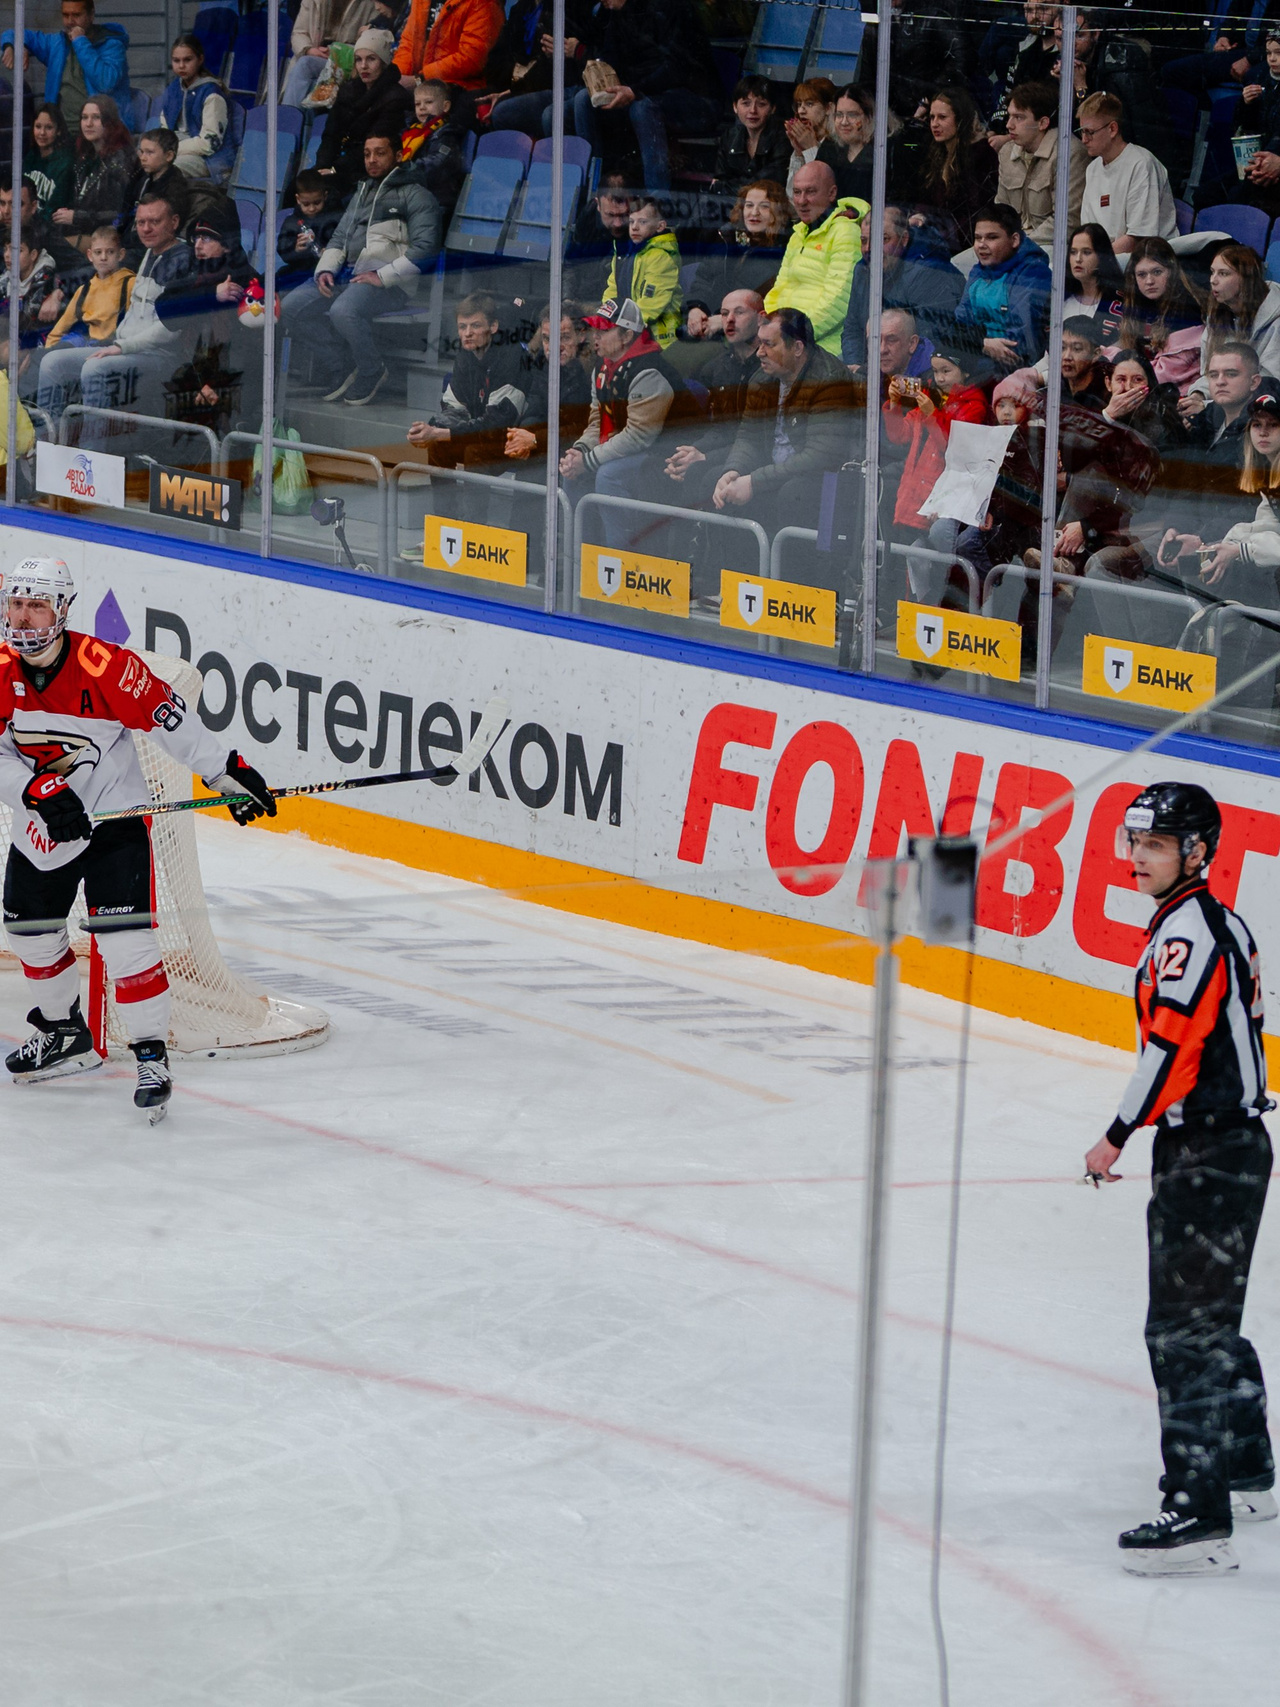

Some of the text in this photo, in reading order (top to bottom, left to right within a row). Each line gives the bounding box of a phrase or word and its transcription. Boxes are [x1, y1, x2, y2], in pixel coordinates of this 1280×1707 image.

[65, 469, 86, 484] АВТО
[70, 482, 96, 498] РАДИО
[160, 472, 230, 523] МАТЧ!
[466, 541, 510, 566] БАНК
[625, 570, 672, 597] БАНК
[767, 599, 817, 625] БАНК
[947, 630, 1001, 659] БАНК
[1137, 665, 1194, 693] БАНК
[80, 689, 94, 715] A
[144, 606, 625, 828] Ростелеком
[40, 776, 68, 795] CC
[284, 782, 348, 797] SOYUZ
[678, 702, 1280, 968] FONBET
[89, 905, 135, 917] G-ENERGY
